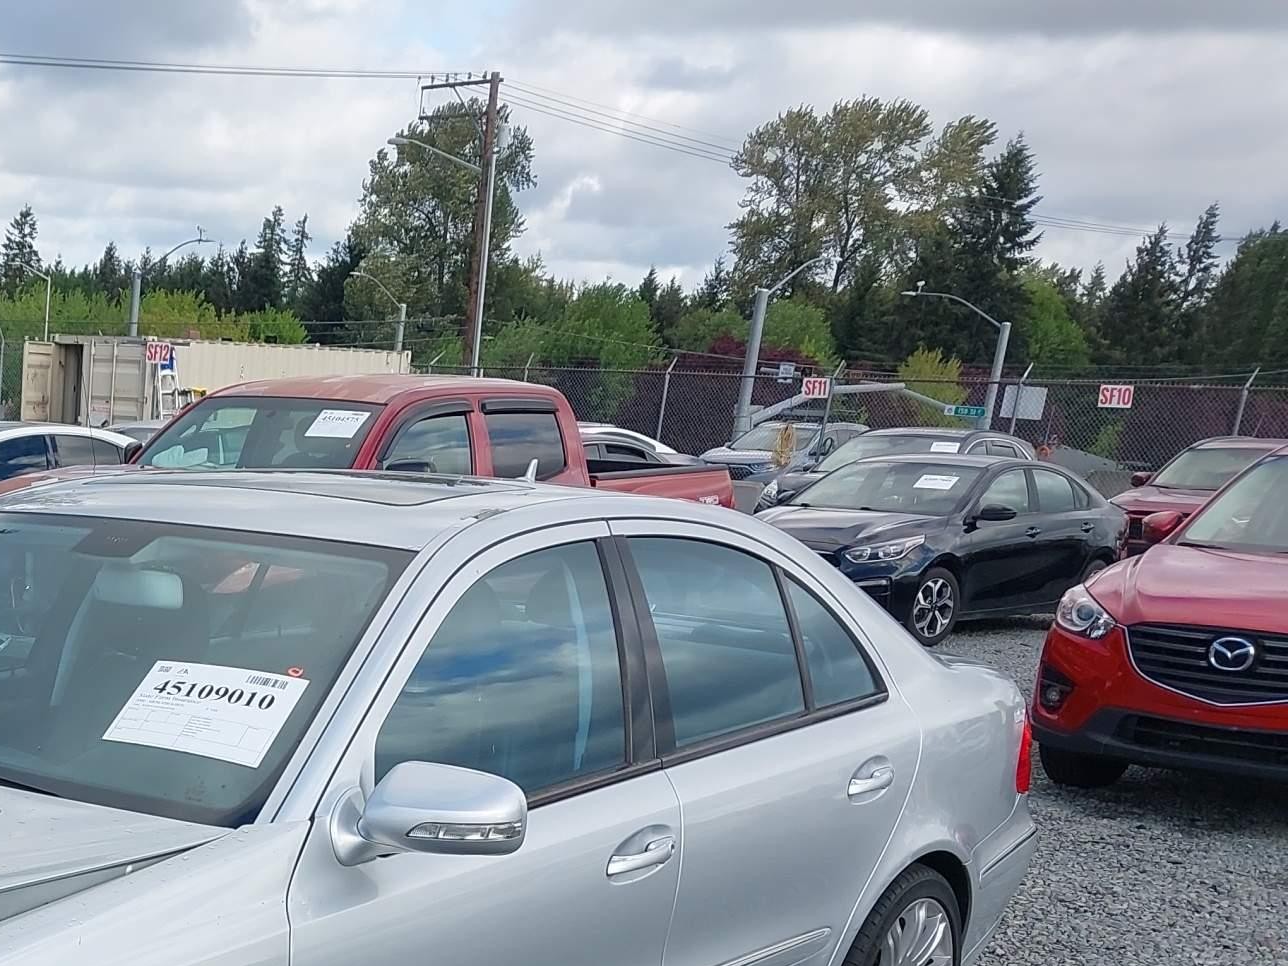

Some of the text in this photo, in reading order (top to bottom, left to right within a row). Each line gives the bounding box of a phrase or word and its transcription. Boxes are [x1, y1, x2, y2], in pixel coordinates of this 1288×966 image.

[147, 343, 170, 361] SF12
[804, 380, 827, 396] SF11
[1100, 386, 1132, 405] SF10
[153, 679, 276, 711] 45109010
